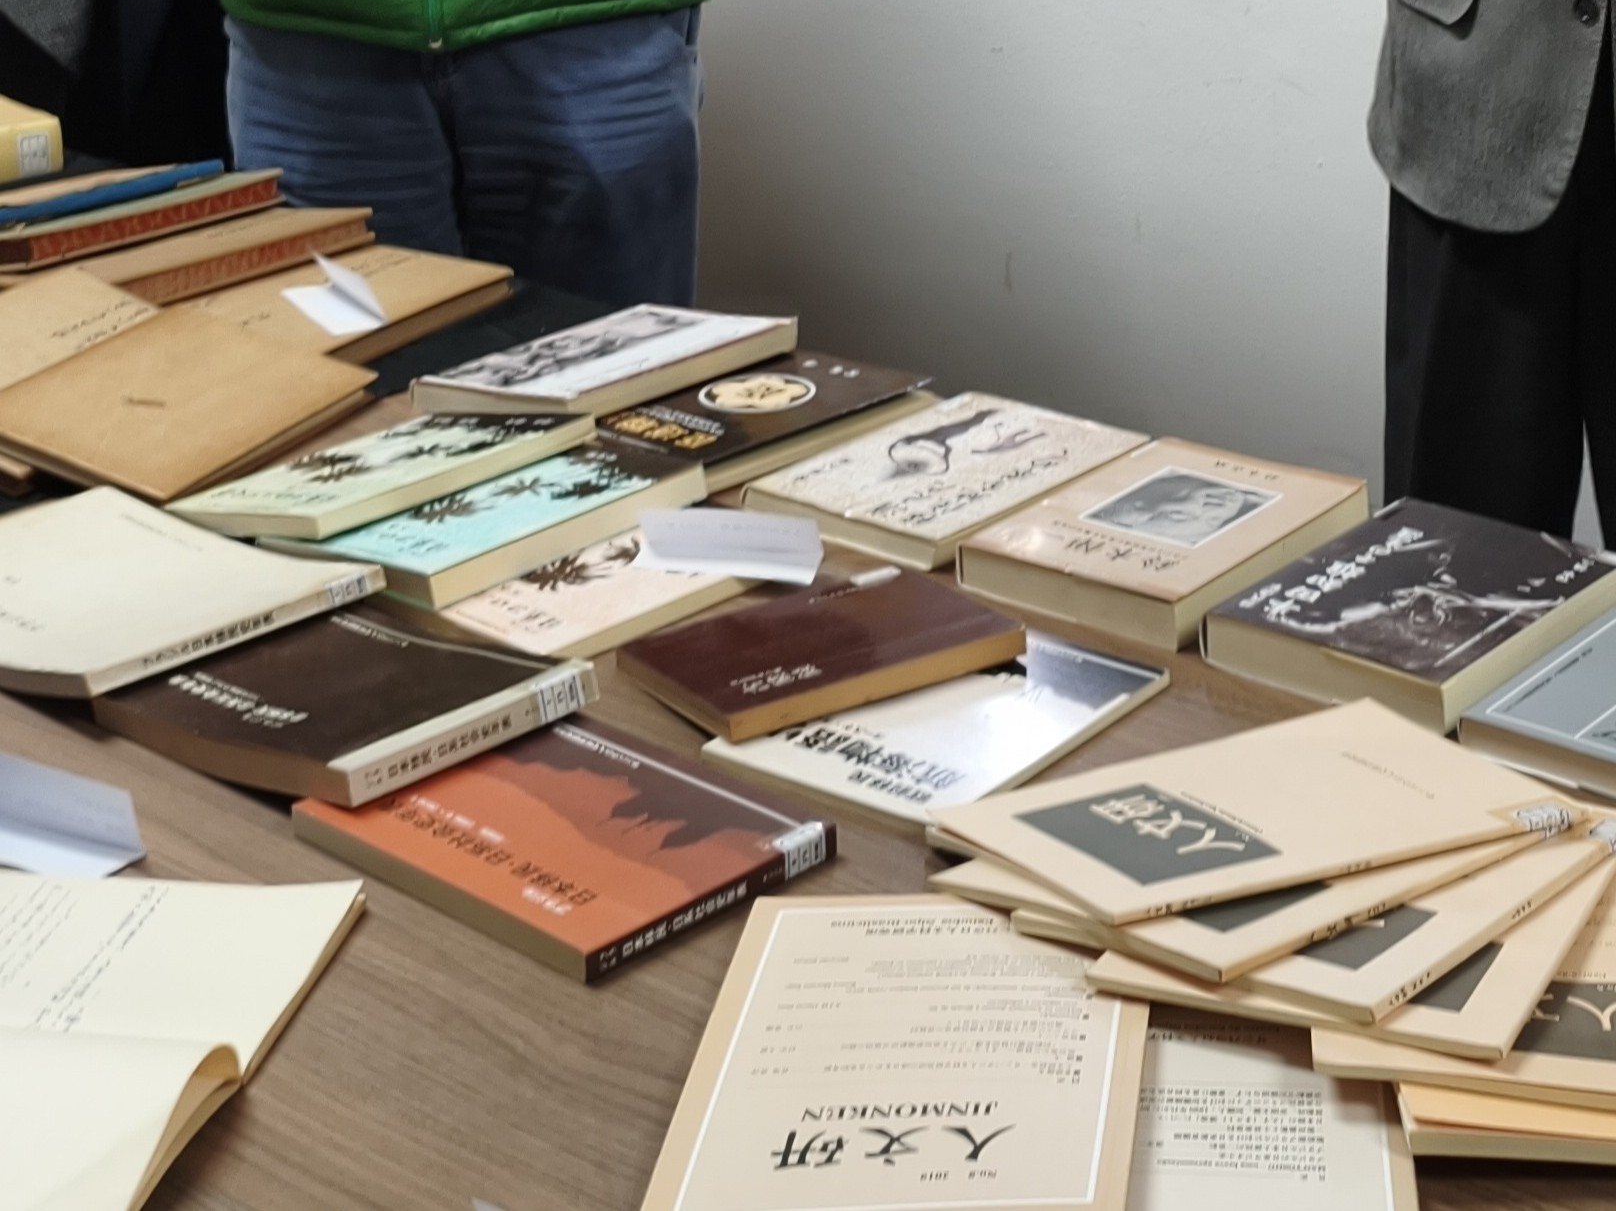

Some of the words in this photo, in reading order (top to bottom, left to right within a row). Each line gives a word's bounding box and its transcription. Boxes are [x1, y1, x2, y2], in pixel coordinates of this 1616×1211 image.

[1088, 785, 1247, 856] 人文研
[802, 1101, 998, 1122] JINMONKEN
[771, 1122, 1016, 1173] 人文研
